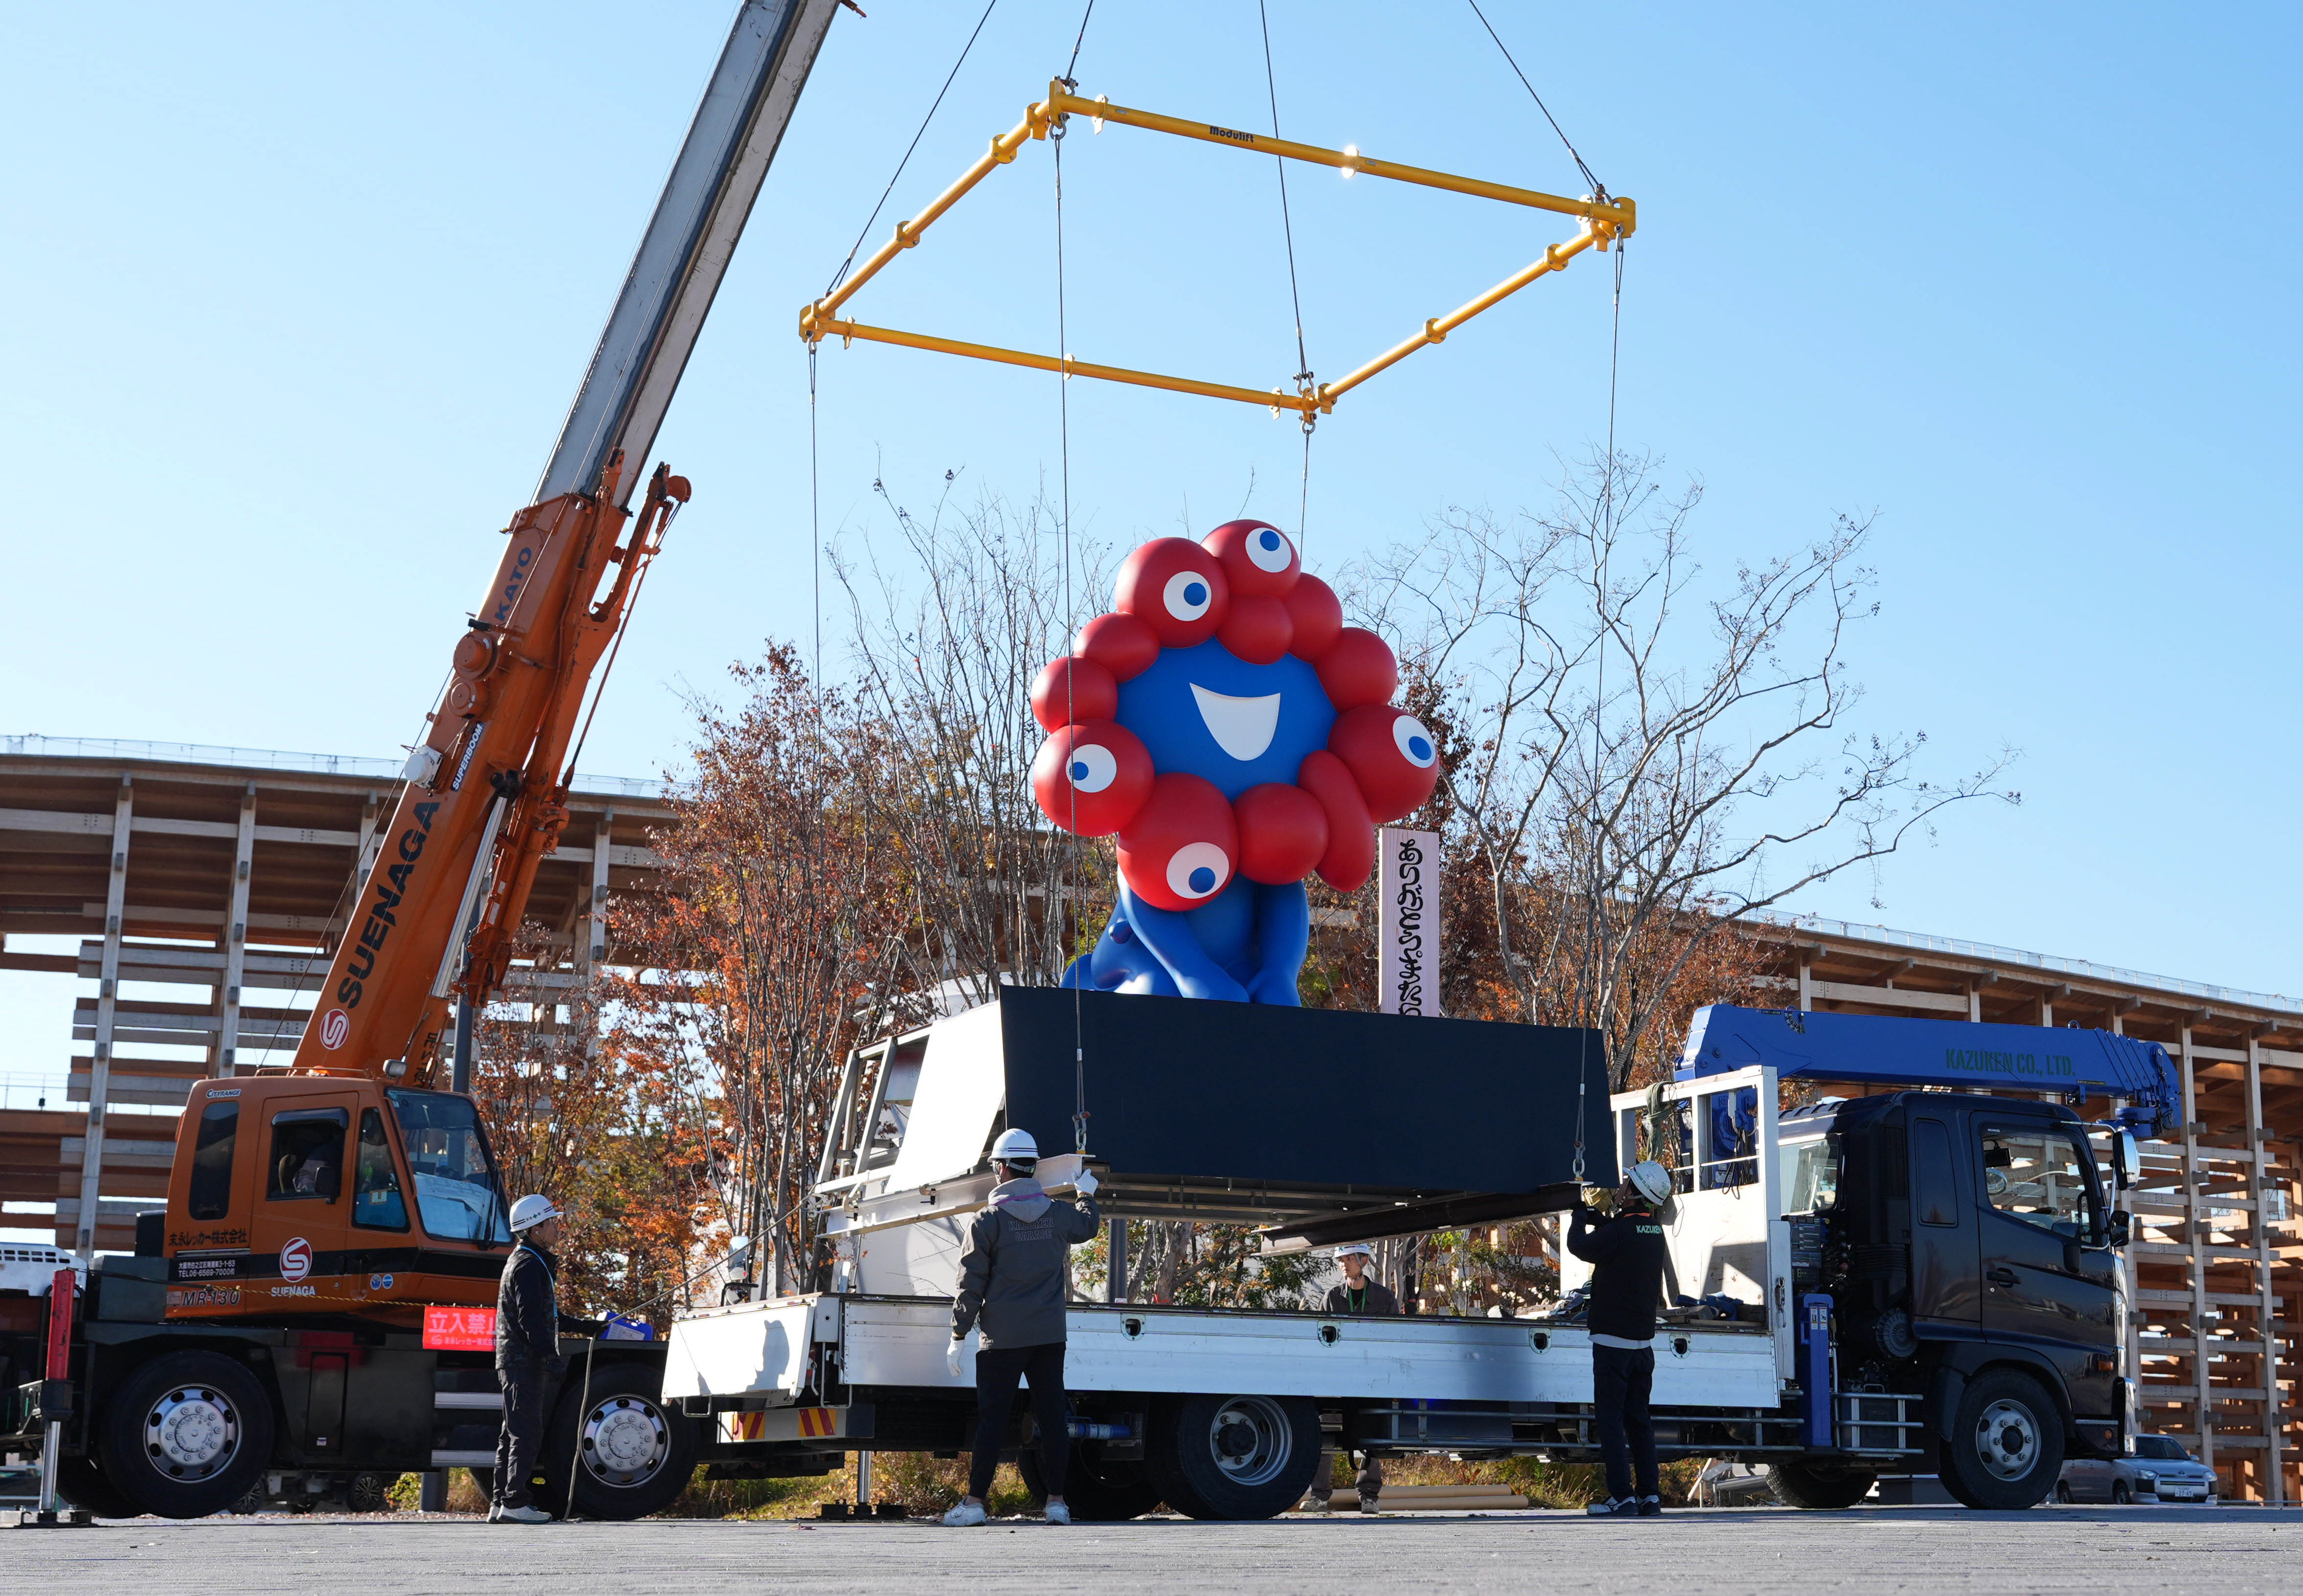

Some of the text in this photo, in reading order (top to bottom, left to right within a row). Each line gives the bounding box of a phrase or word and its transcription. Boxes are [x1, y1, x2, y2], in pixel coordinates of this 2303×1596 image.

[494, 547, 532, 622] KATO
[452, 723, 484, 790] SUPERBOOM
[337, 801, 441, 1009] SUENAGA
[1946, 1048, 2013, 1073] KAZUKEN
[1008, 1217, 1054, 1231] KAZUKEN
[1636, 1225, 1662, 1234] KAZUKEN
[1015, 1229, 1053, 1242] GARAGE
[182, 1290, 241, 1306] MR-130
[271, 1286, 316, 1296] SUENAGA
